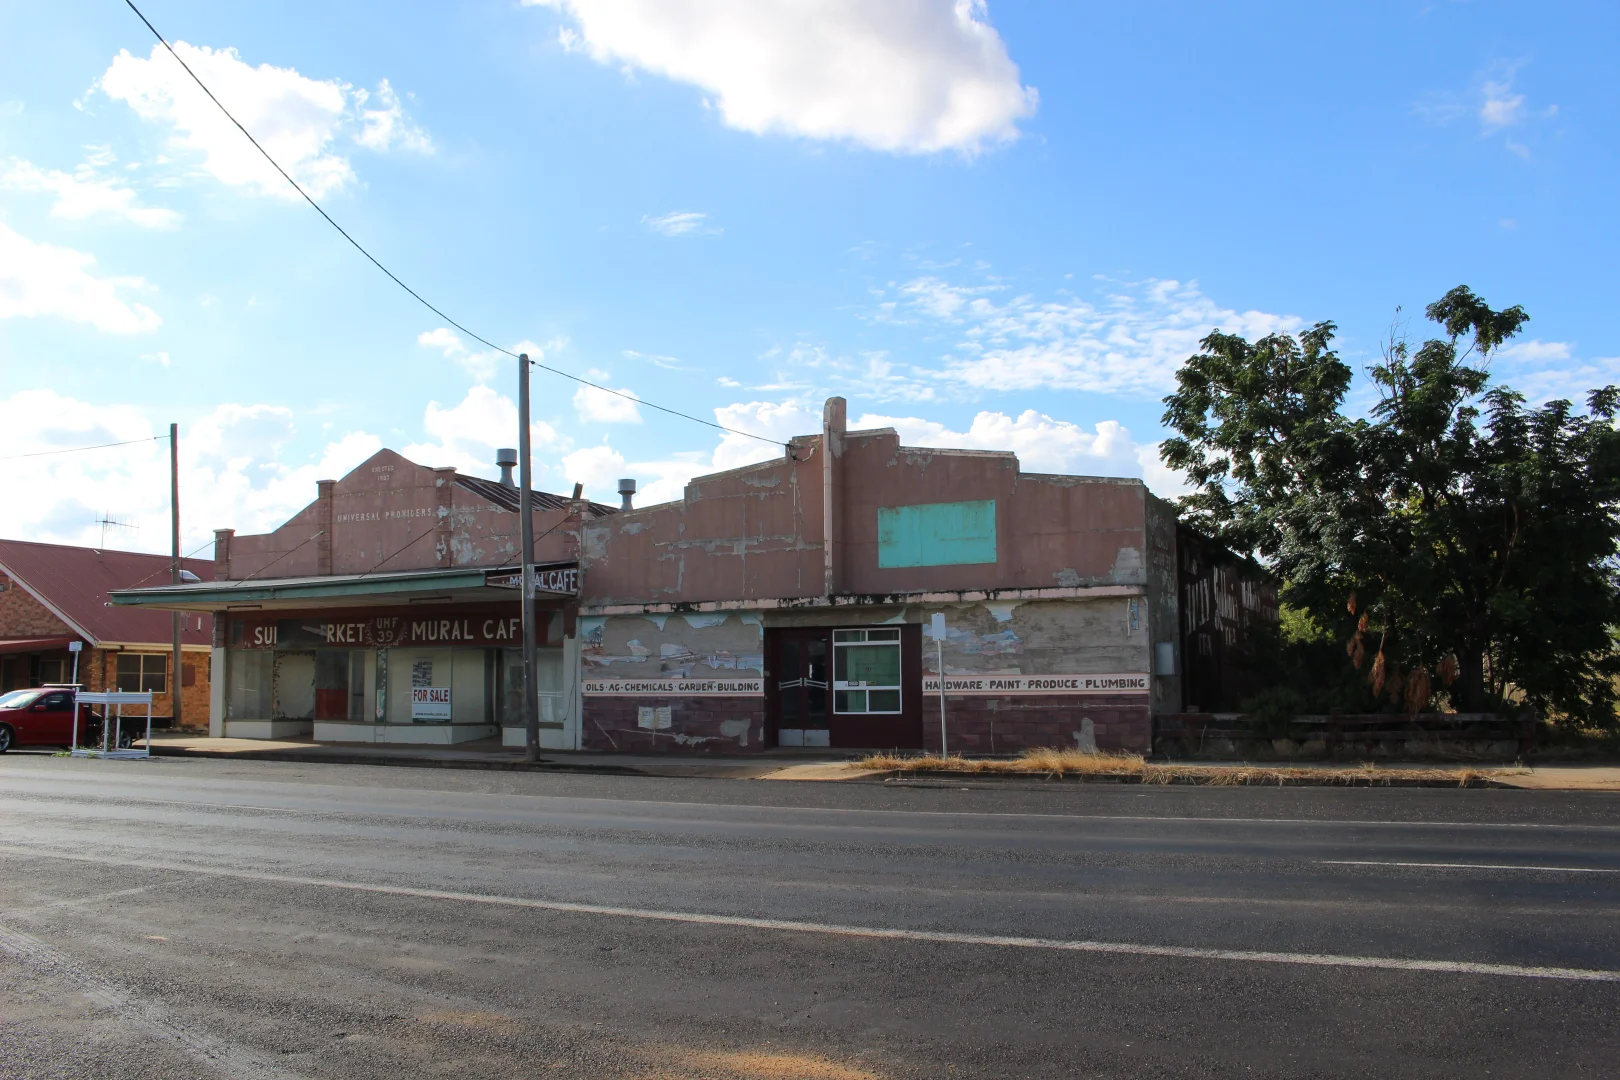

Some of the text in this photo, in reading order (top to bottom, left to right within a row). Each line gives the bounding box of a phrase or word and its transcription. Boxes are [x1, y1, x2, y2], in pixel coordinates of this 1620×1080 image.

[337, 507, 432, 523] UNIVERSAL PROVIDERS
[509, 569, 578, 592] MAL CAFE
[376, 616, 399, 629] UHF
[377, 630, 394, 642] 39
[411, 618, 521, 641] MURAL CAF
[586, 683, 604, 691] OILS
[678, 683, 713, 691] GARDEN
[717, 682, 760, 691] BUILDING
[989, 680, 1021, 689] PAINT
[1027, 679, 1078, 689] PRODUCE
[1085, 678, 1145, 689] PLUMBING
[413, 689, 449, 703] FOR SALE
